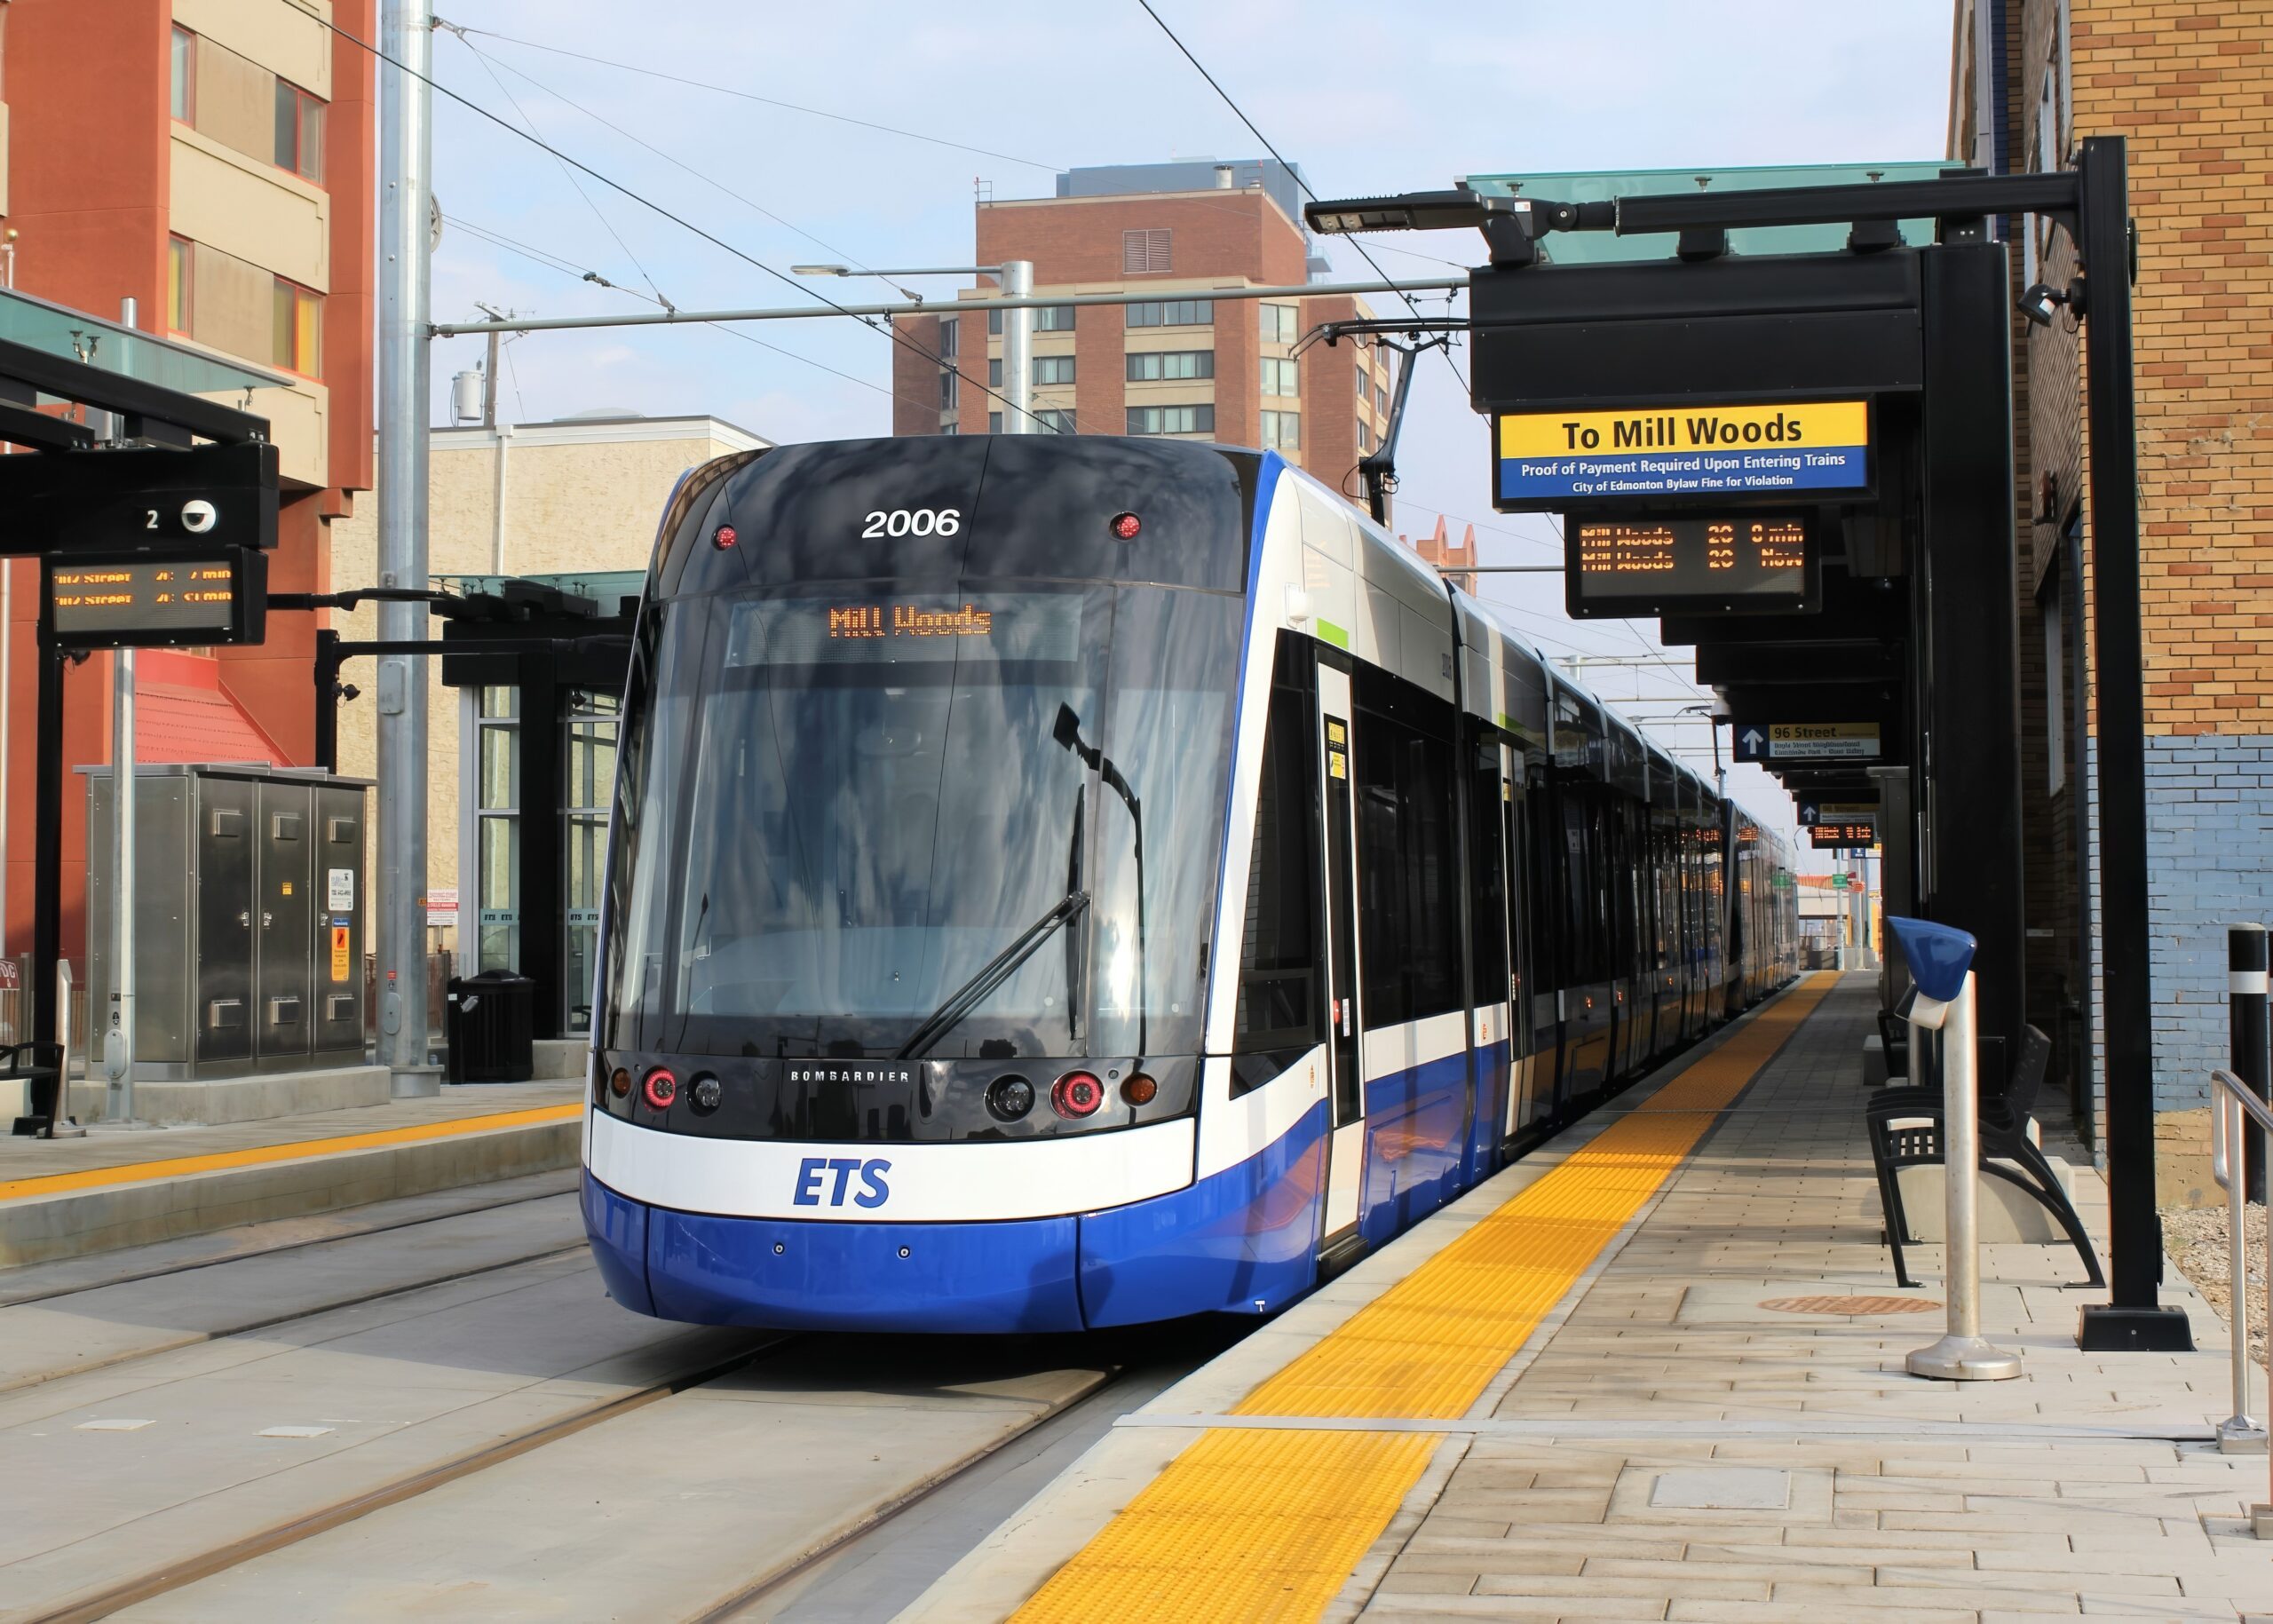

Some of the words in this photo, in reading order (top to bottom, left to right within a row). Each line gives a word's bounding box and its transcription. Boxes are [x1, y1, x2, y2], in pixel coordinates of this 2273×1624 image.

[1562, 423, 1600, 450] To
[1613, 416, 1675, 448] Mill
[1686, 412, 1802, 445] Woods
[1521, 462, 1558, 477] Proof
[1561, 461, 1576, 475] of
[1579, 460, 1637, 478] Payment
[1640, 456, 1700, 474] Required
[1704, 456, 1739, 473] Upon
[1744, 454, 1802, 470] Entering
[1804, 452, 1846, 466] Trains
[1572, 481, 1594, 494] City
[1596, 480, 1609, 492] of
[1610, 479, 1663, 491] Edmonton
[1666, 479, 1699, 491] Bylaw
[1701, 477, 1724, 488] Fine
[1725, 476, 1742, 487] for
[1744, 474, 1794, 487] Violation
[147, 510, 158, 529] 2
[861, 509, 962, 539] 2006
[829, 606, 886, 638] Mill
[894, 605, 992, 637] Woods
[1774, 726, 1791, 740] 96
[1794, 725, 1837, 739] Street
[790, 1070, 909, 1083] BOMBARDIER
[793, 1157, 893, 1209] ETS
